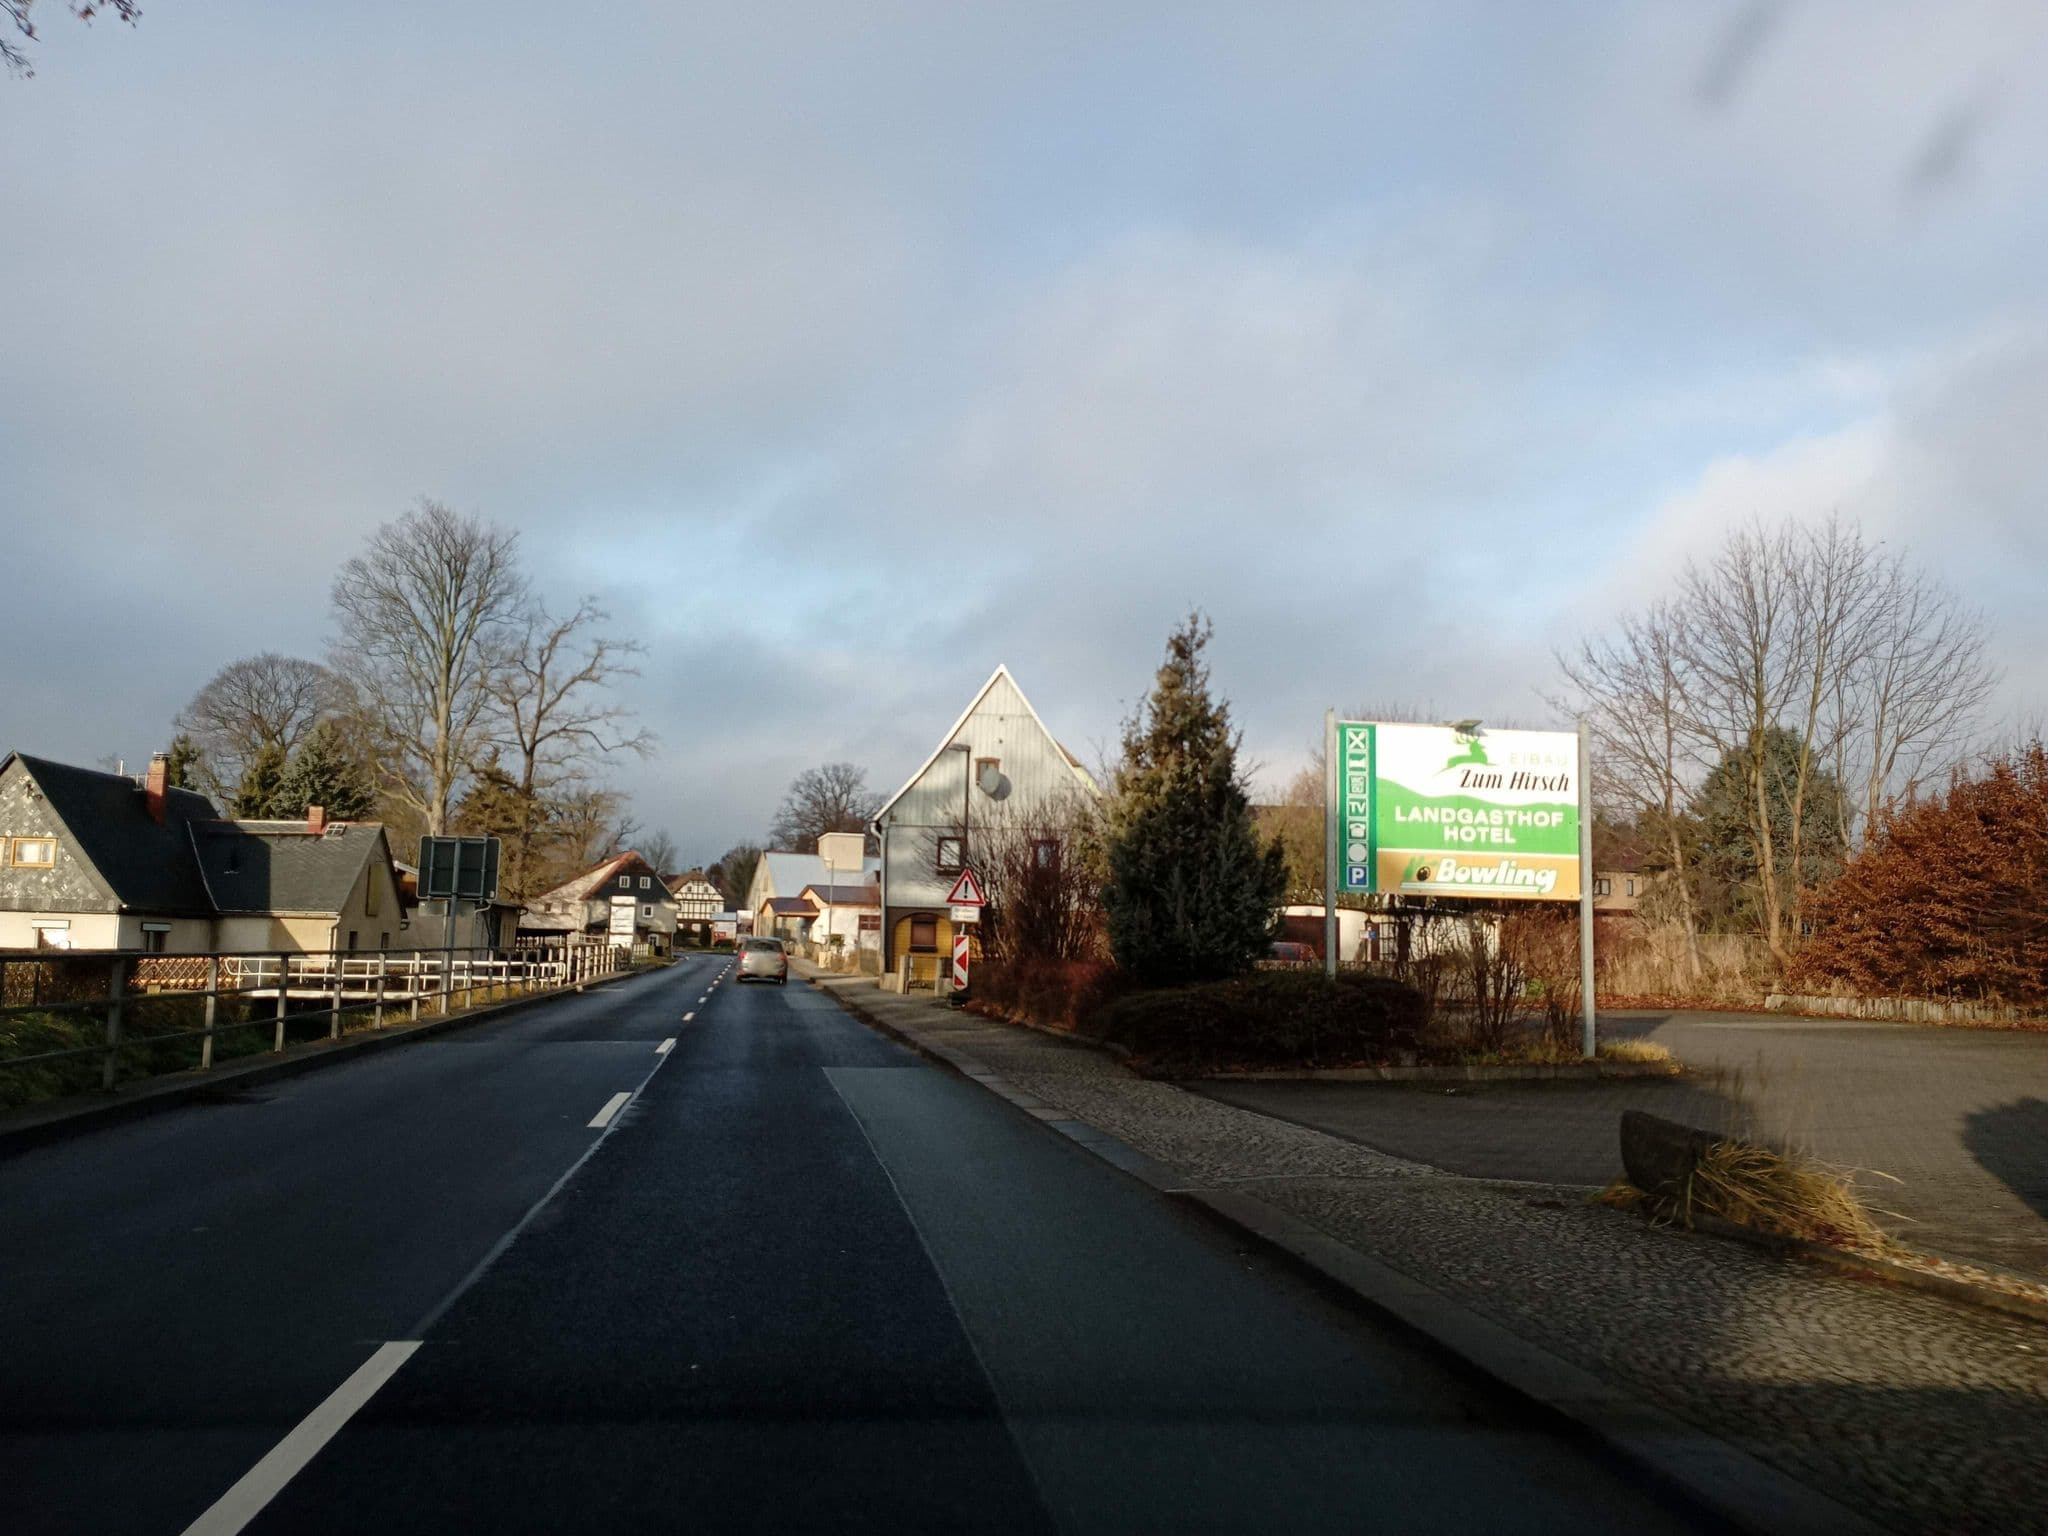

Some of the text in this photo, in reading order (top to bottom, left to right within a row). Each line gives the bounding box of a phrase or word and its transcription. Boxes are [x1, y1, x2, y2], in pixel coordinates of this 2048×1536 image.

[1460, 769, 1569, 792] Zum Hirsch
[1349, 802, 1366, 814] TV
[1395, 806, 1564, 828] LANDGASTHOF
[1444, 826, 1516, 844] HOTEL
[1351, 869, 1363, 884] P
[1437, 858, 1557, 892] Bowling
